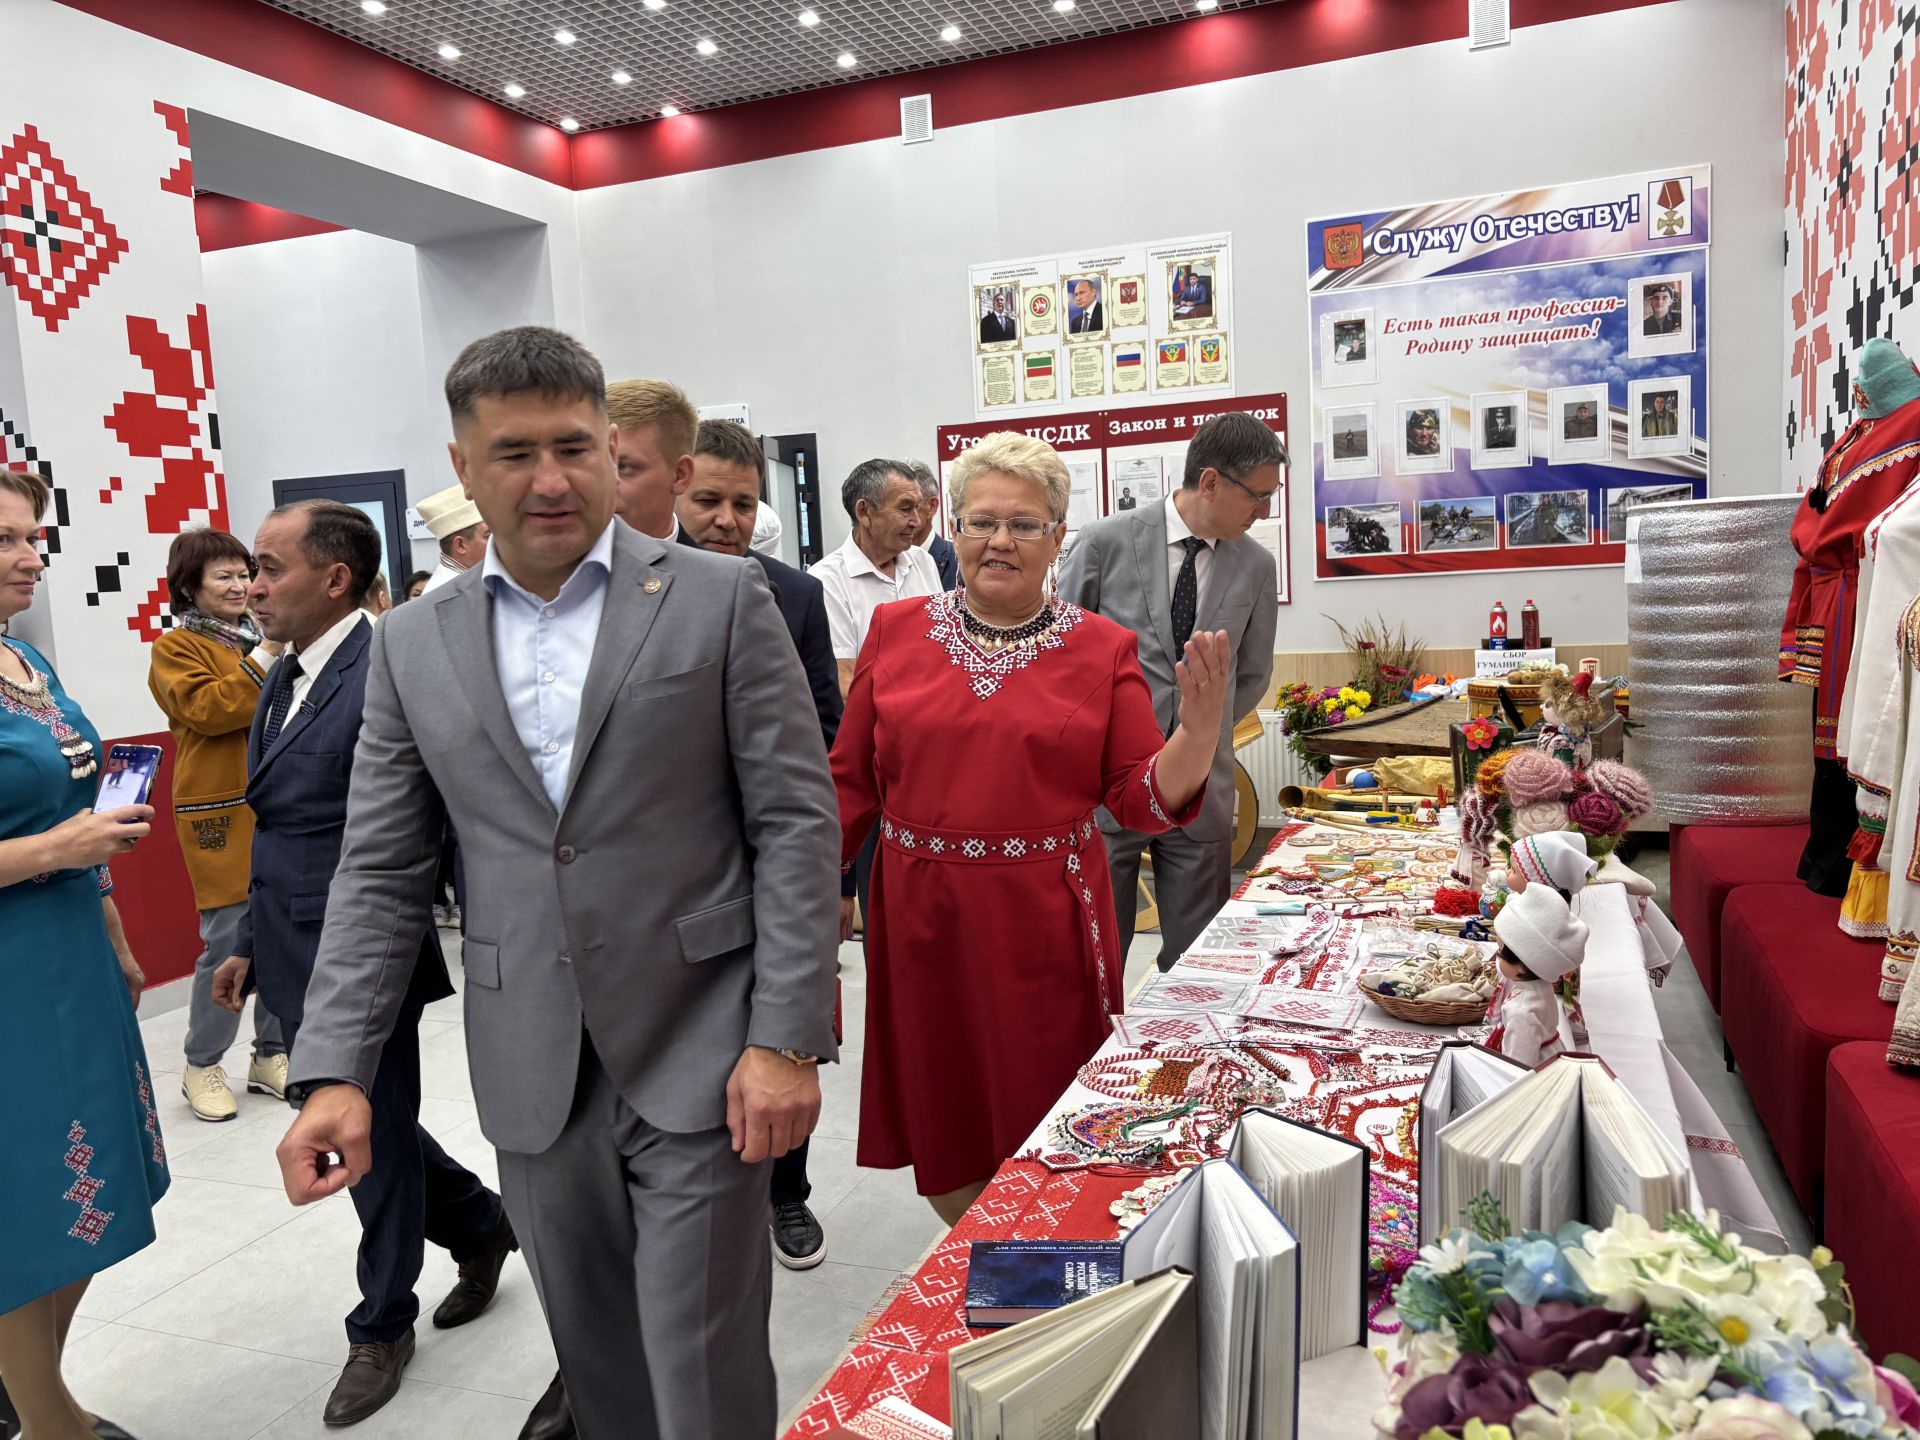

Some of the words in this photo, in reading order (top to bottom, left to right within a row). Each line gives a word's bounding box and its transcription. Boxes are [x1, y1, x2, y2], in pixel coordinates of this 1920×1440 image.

[1371, 224, 1467, 258] Служу
[1471, 194, 1640, 244] Отечеству!
[1383, 318, 1433, 335] Есть
[1439, 310, 1501, 329] такая
[1507, 298, 1626, 325] профессия-
[1404, 337, 1474, 357] Родину
[1478, 318, 1602, 349] защищать!
[1108, 417, 1167, 435] Закон
[1173, 416, 1186, 428] и
[1065, 1261, 1074, 1290] СЛОВАРЬ
[1076, 1261, 1088, 1290] РУССКИЙ
